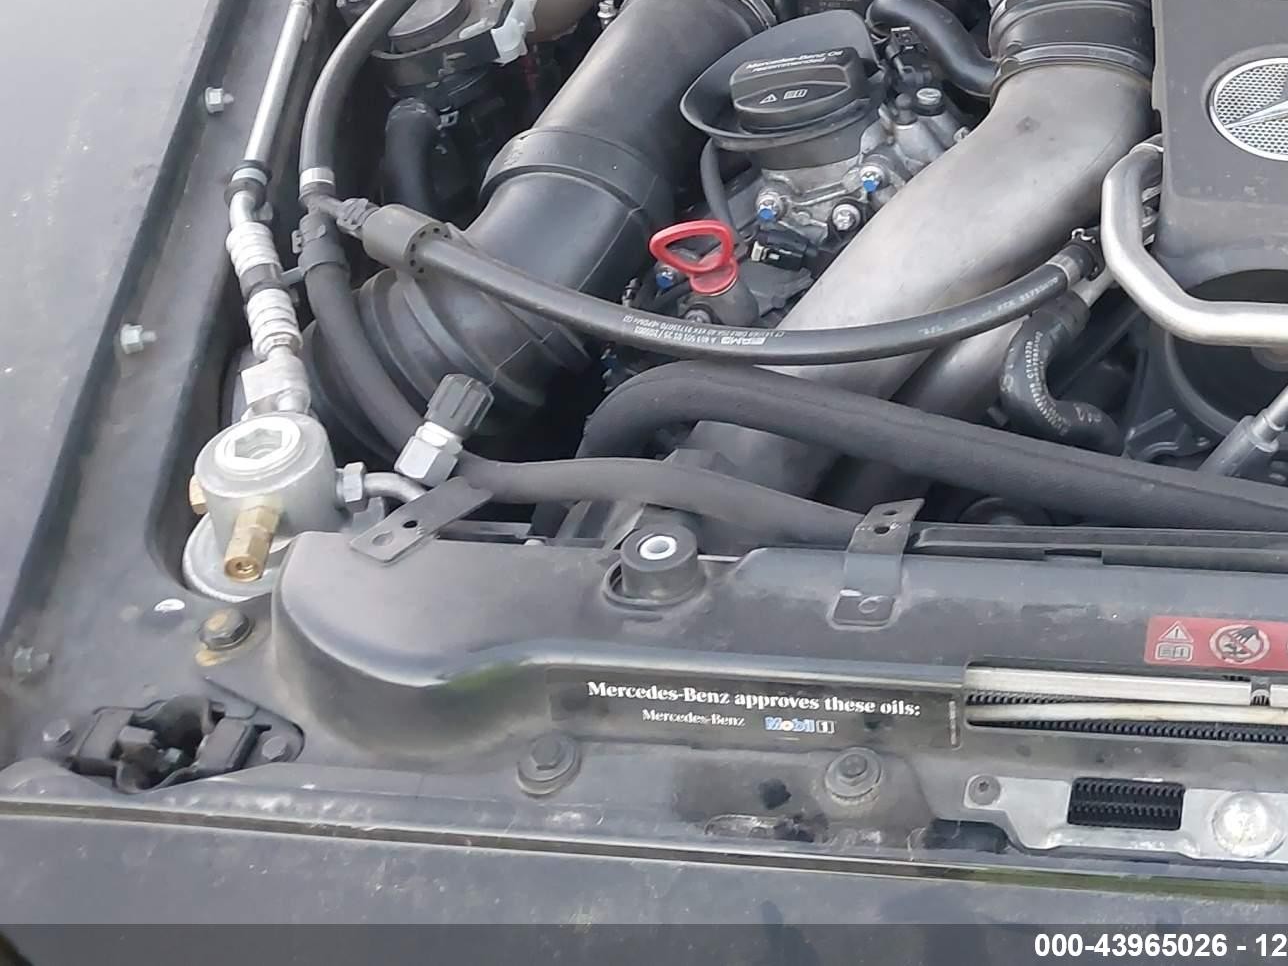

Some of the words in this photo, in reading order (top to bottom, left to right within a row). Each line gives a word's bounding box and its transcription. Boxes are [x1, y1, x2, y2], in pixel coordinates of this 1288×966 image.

[587, 681, 730, 705] Mercedes-Benz
[734, 693, 820, 710] approves
[824, 696, 875, 713] these
[880, 700, 921, 716] oils:
[642, 709, 746, 727] Mercedes-Benz
